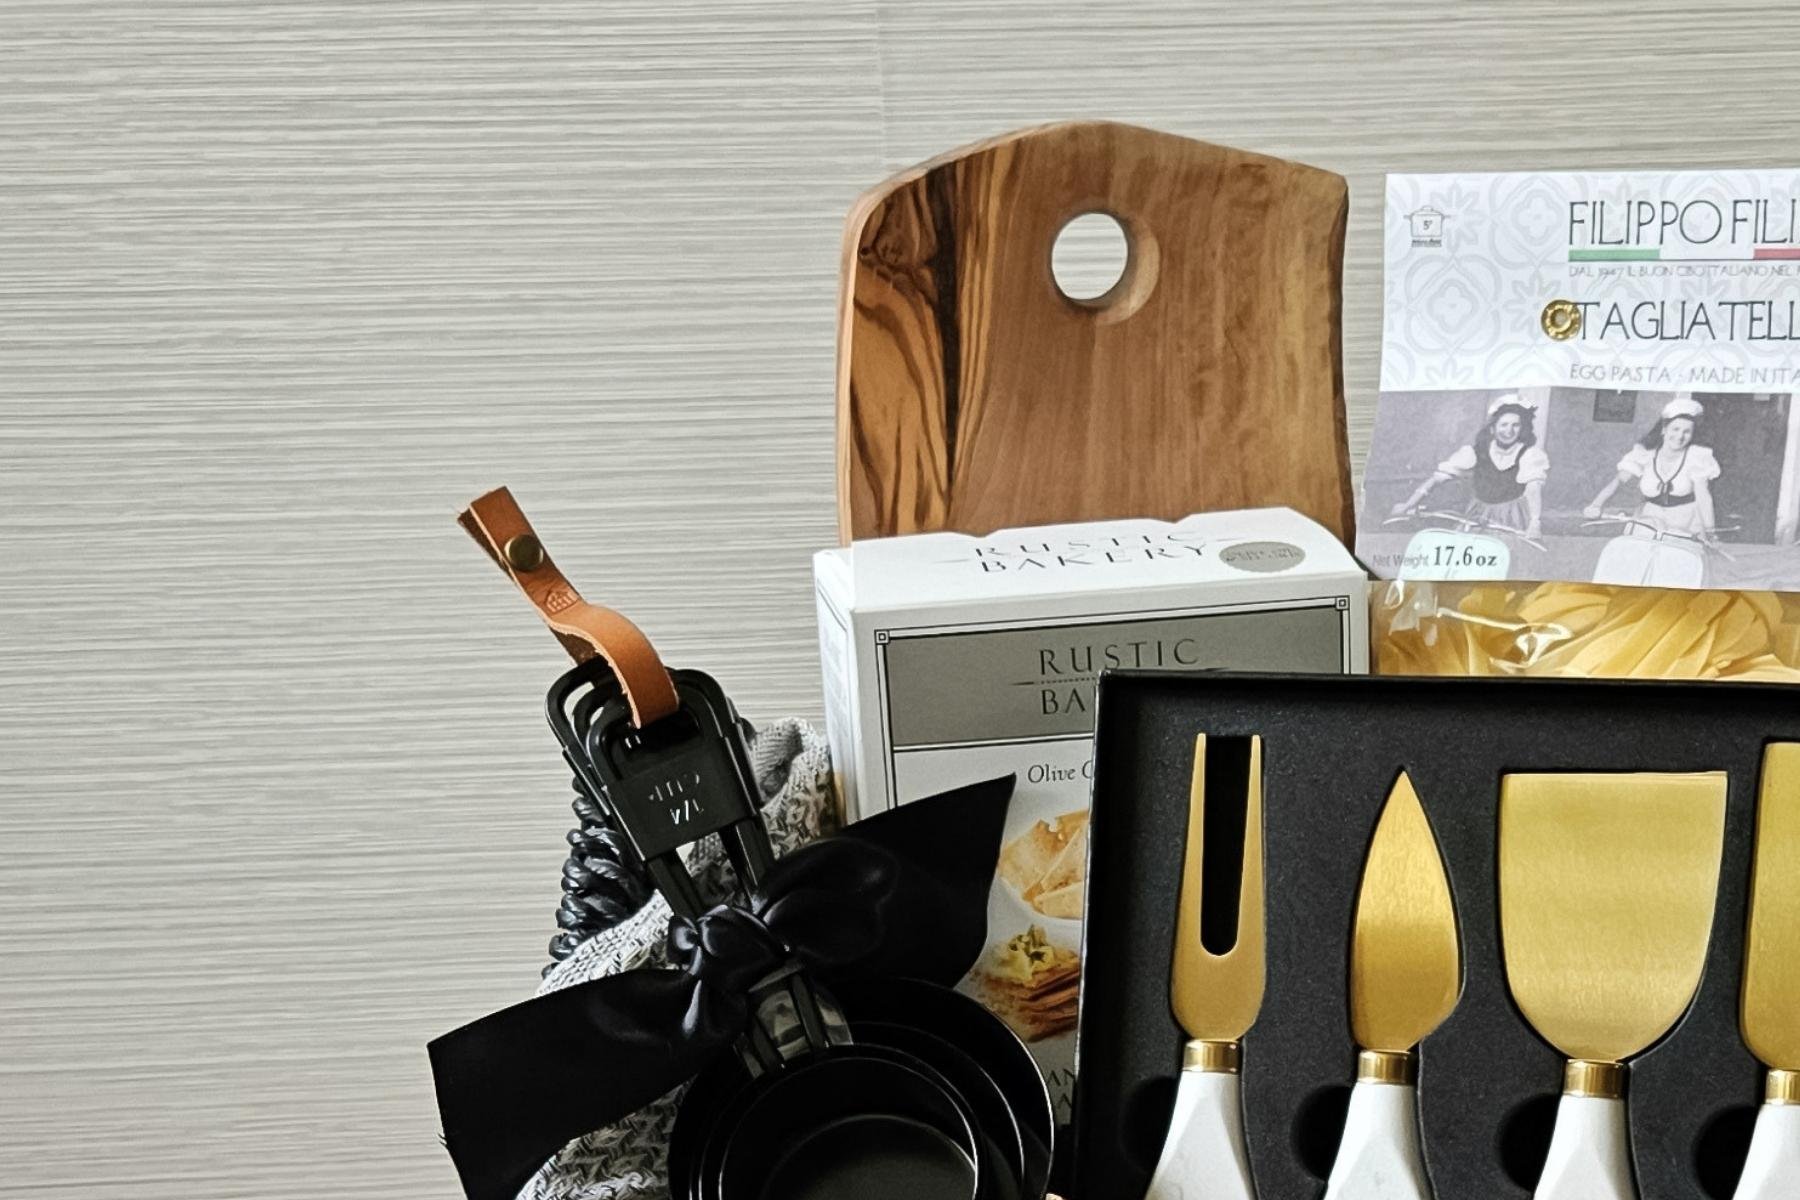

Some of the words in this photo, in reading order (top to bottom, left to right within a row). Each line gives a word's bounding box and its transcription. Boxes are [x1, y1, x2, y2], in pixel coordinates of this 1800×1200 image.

[1568, 200, 1723, 245] FILIPPO
[1731, 198, 1800, 244] FILI
[1576, 300, 1800, 342] TAGLIATELL
[1569, 364, 1607, 381] EGG
[1611, 366, 1672, 384] PASTA
[1689, 366, 1745, 384] MADE
[1750, 367, 1768, 384] IN
[1771, 367, 1800, 385] ITA
[981, 543, 1207, 573] BAKERY
[1433, 545, 1474, 567] 17.6
[1475, 554, 1498, 567] oz
[1039, 638, 1199, 676] RUSTIC
[1027, 762, 1076, 784] Olive
